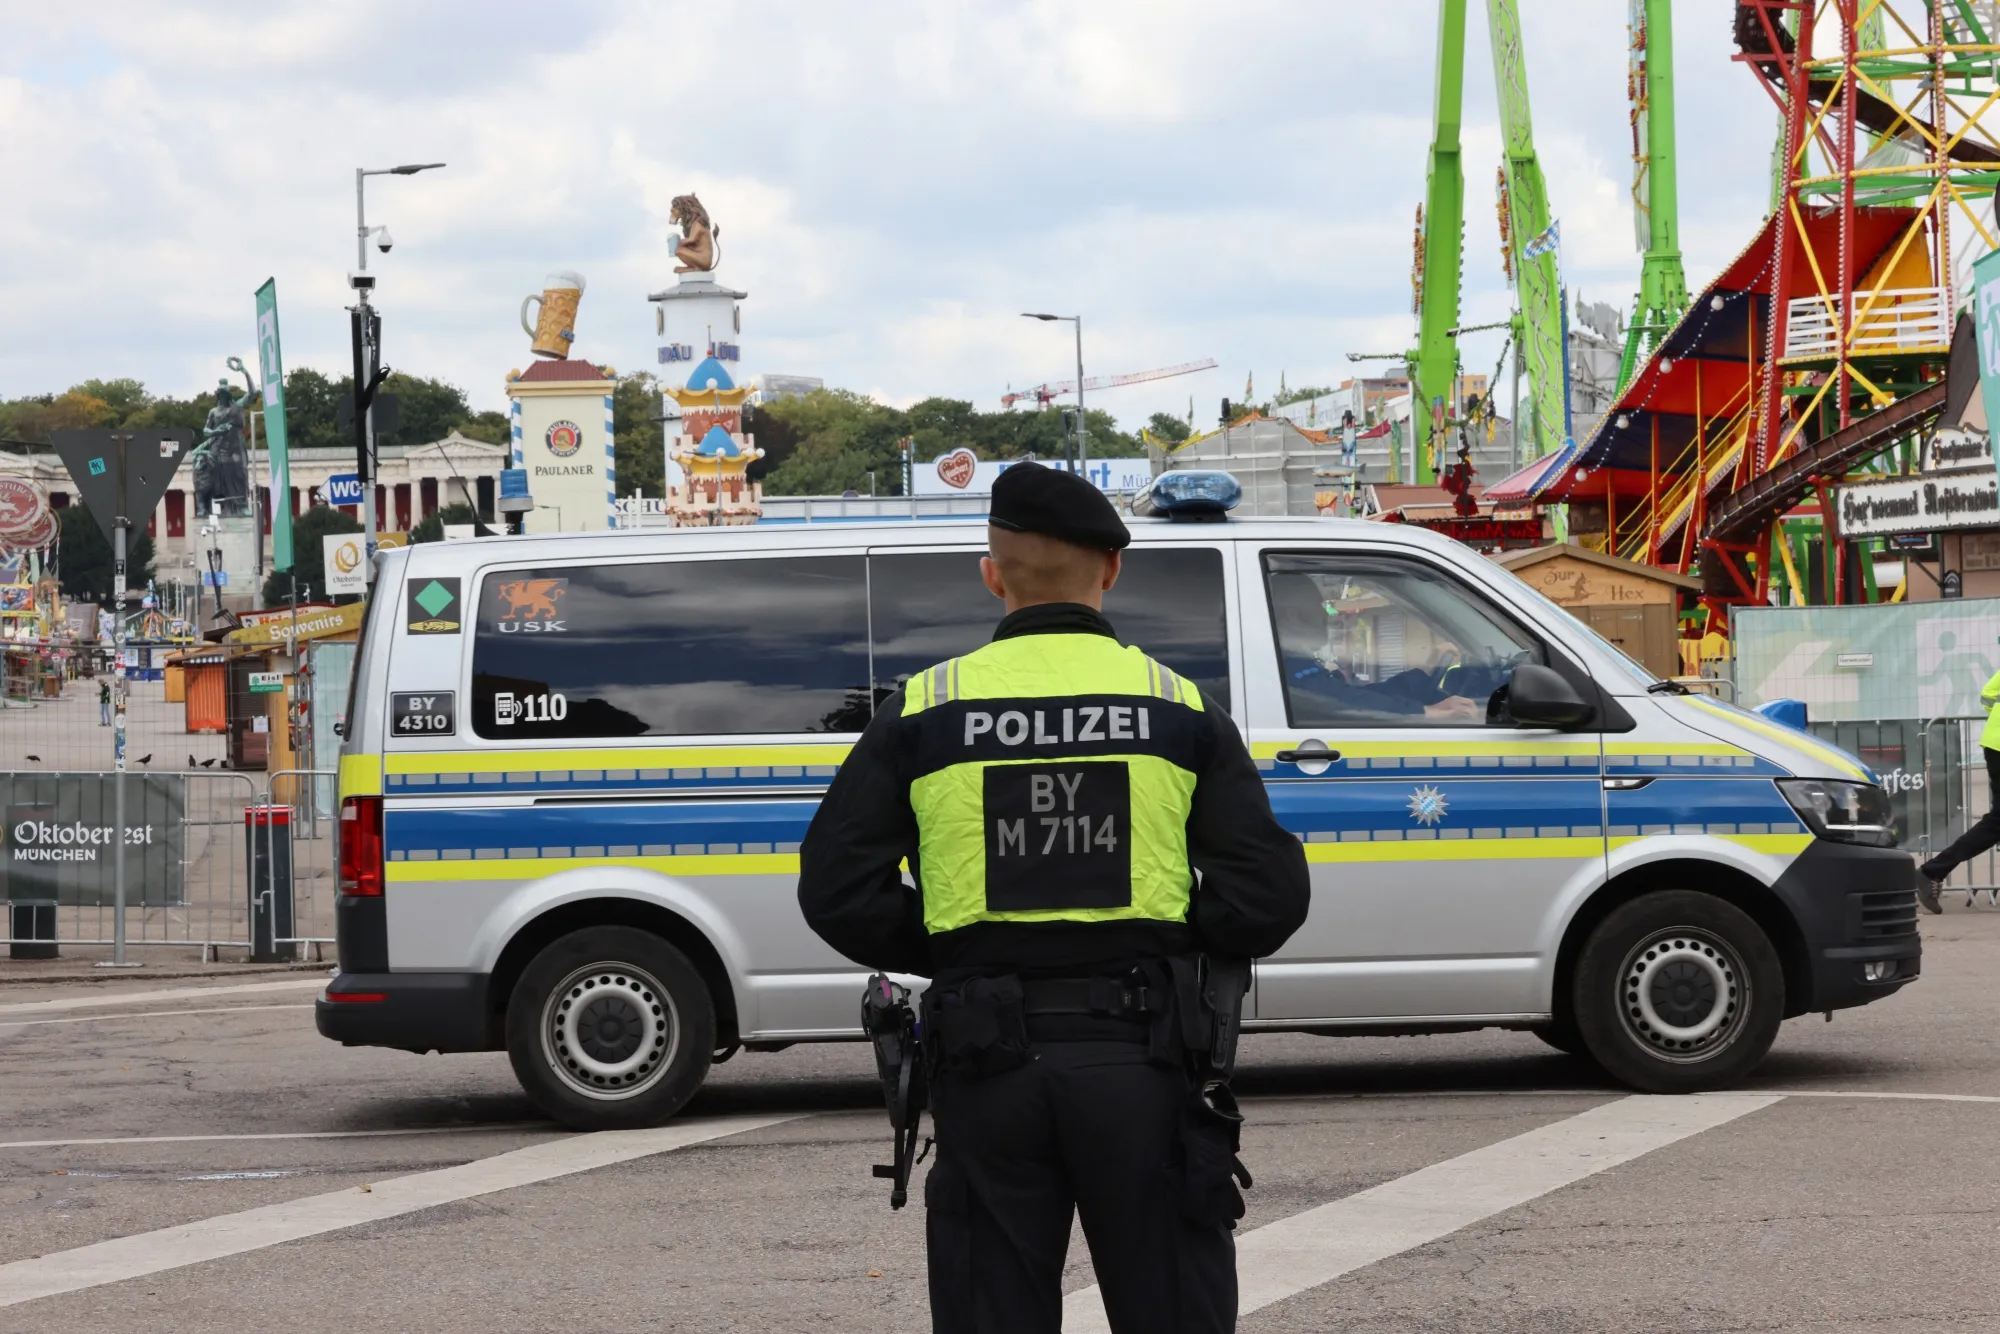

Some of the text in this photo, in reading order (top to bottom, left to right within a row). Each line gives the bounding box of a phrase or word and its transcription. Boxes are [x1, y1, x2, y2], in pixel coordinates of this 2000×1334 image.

[535, 465, 594, 476] PAULANER
[331, 481, 361, 498] WC
[1543, 568, 1576, 585] Zur
[1610, 585, 1644, 601] Hex
[269, 613, 344, 640] Souvenirs
[497, 620, 568, 633] USK
[408, 697, 437, 712] BY
[523, 693, 568, 722] 110
[399, 714, 448, 731] 4310
[964, 705, 1150, 746] POLIZEI
[1031, 772, 1084, 813] BY
[14, 820, 154, 845] Oktoberest
[997, 814, 1118, 856] M 7114
[14, 848, 97, 861] MÜNCHEN
